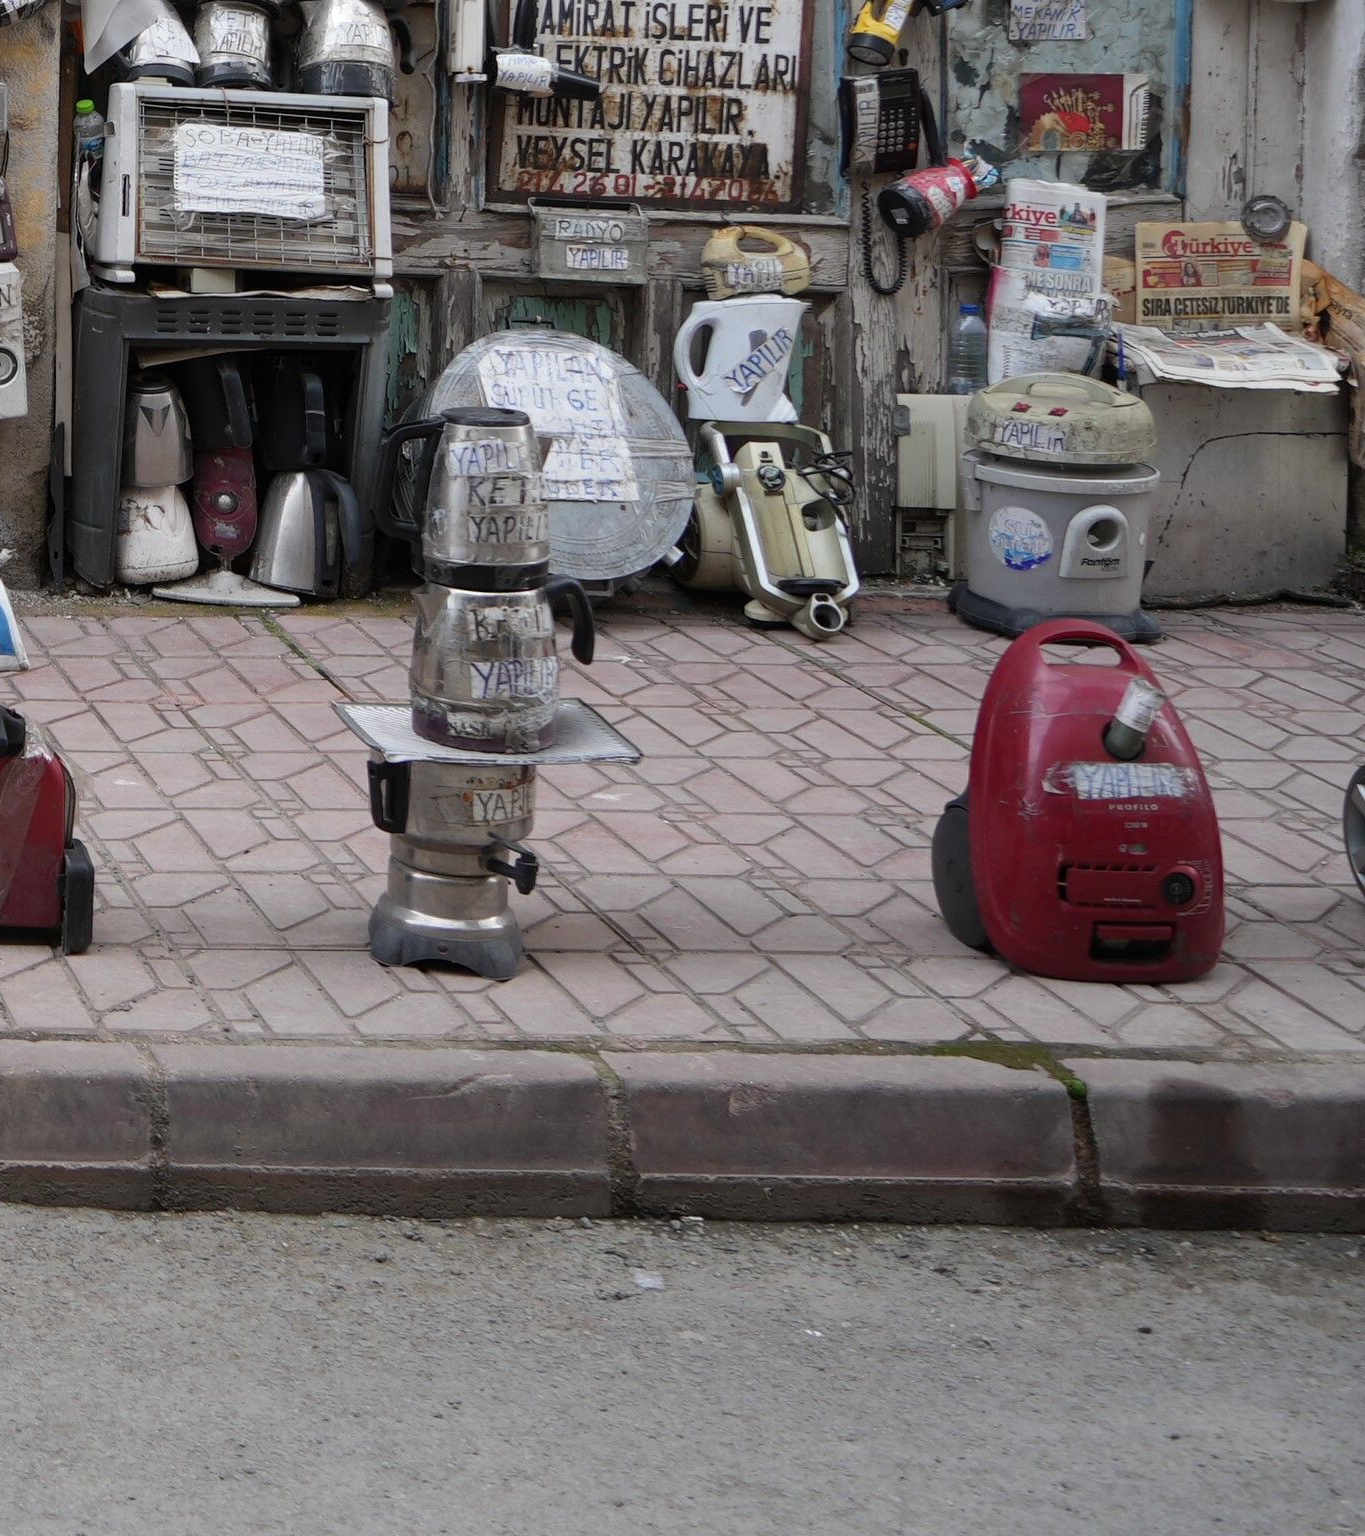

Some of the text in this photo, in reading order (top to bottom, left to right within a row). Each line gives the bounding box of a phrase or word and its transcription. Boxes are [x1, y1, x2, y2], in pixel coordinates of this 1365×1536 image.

[740, 4, 771, 44] VE
[517, 135, 769, 177] VEYSEL KARAKAYA
[1142, 297, 1172, 316] SIRA
[723, 328, 793, 393] YAPILIR
